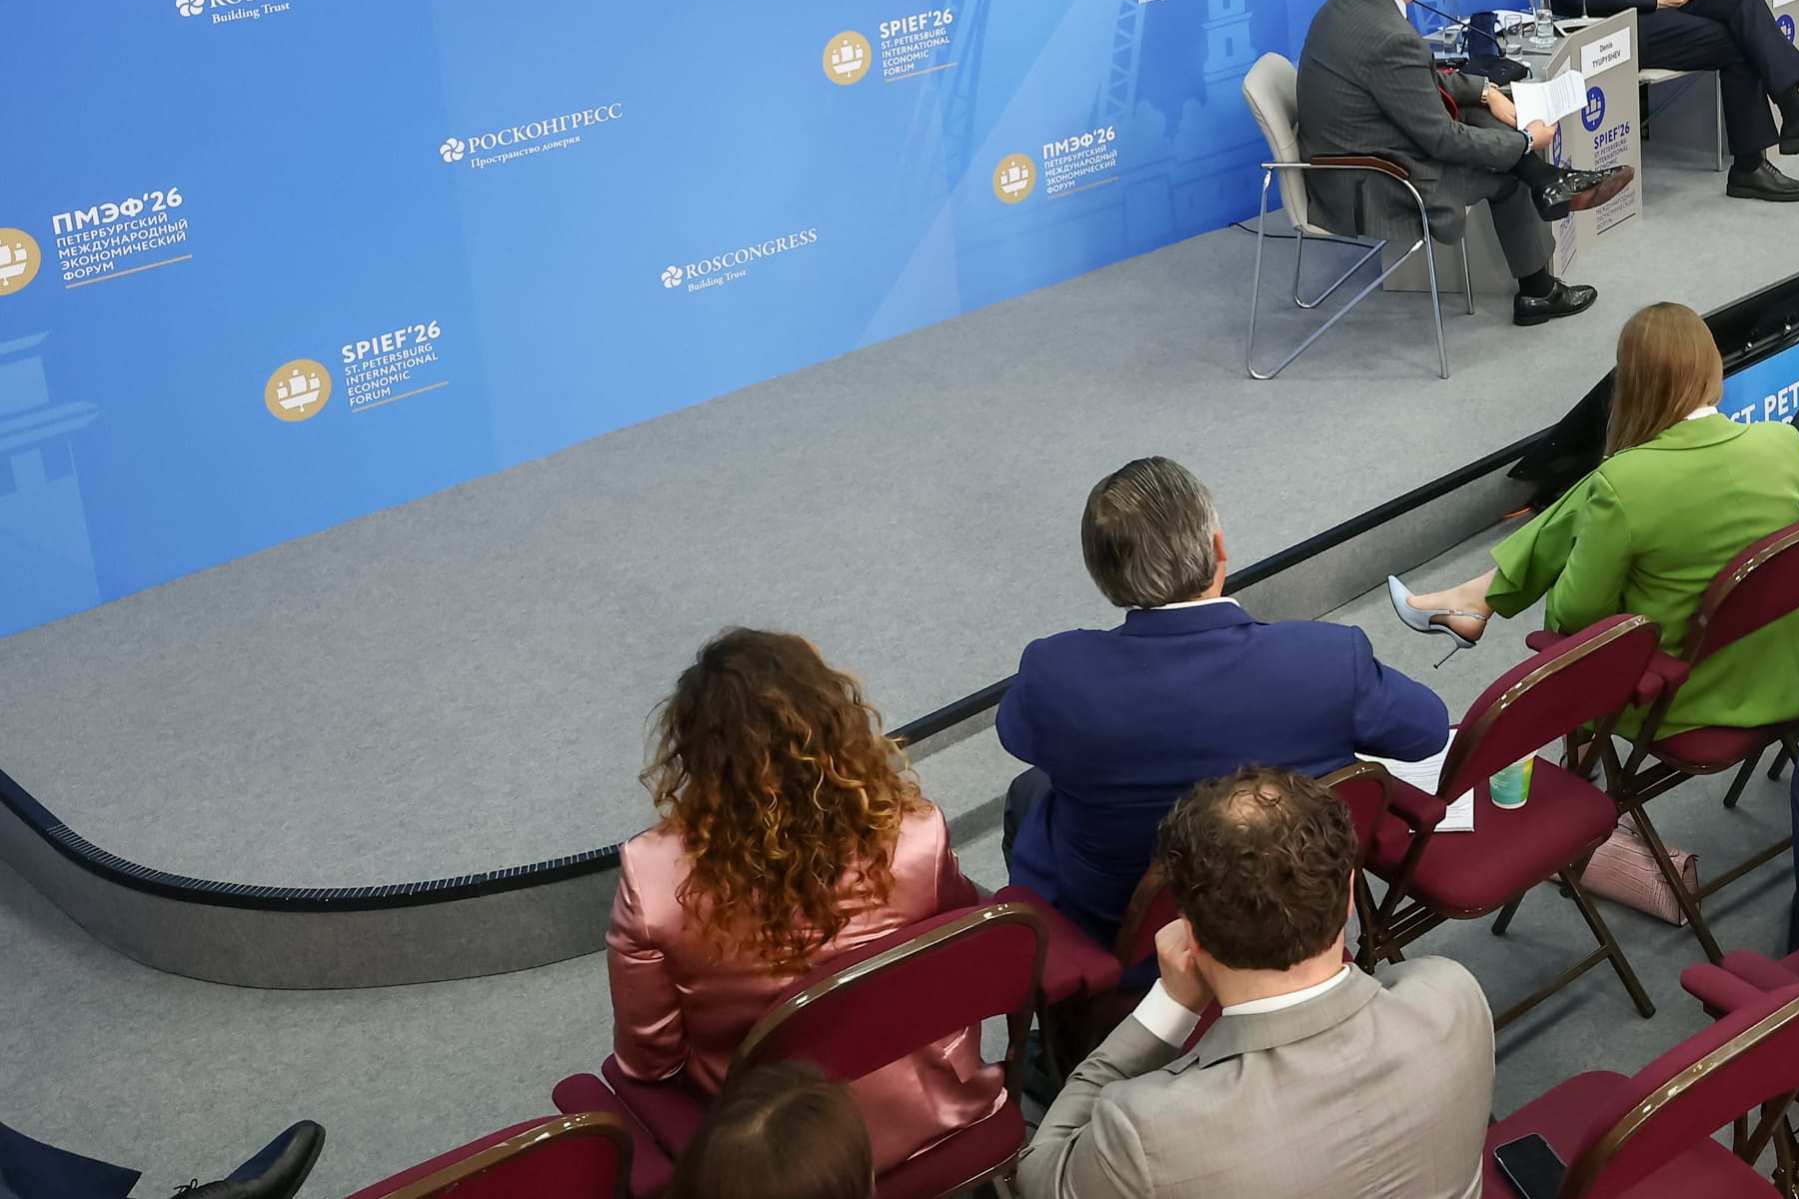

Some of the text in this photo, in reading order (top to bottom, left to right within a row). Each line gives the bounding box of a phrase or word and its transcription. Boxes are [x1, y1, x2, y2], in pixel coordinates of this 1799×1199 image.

[211, 1, 291, 24] Building Trust
[879, 8, 953, 39] SPIEF'26
[881, 37, 950, 59] INTERNATIONAL
[895, 28, 946, 46] PETERSBURG
[882, 50, 929, 68] ECONOMIC
[883, 63, 915, 77] FORUM
[468, 103, 624, 153] РОСКОНГРЕСС
[1043, 125, 1116, 159] ПМЭФ'26
[1593, 122, 1630, 149] SPIEF'26
[471, 135, 581, 168] Пространство доверия
[1045, 149, 1118, 177] МЕЖДУНАРОДНЫЙ
[1047, 159, 1116, 186] ЭКОНОМИЧЕСКИЙ
[1047, 180, 1076, 194] ФОРУМ
[52, 187, 183, 235] ПМЭФ'26
[56, 211, 168, 248] ПЕТЕРБУРГСКИЙ
[58, 218, 189, 260] МЕЖДУНАРОДНЫЙ
[61, 230, 187, 271] ЭКОНОМИЧЕСКИЙ
[686, 227, 818, 280] ROSCONGRESS
[63, 260, 115, 281] ФОРУМ
[342, 319, 441, 363] SPIEF'26
[344, 343, 433, 376] ST. PETERSBURG
[346, 352, 439, 387] INTERNATIONAL
[348, 371, 410, 397] ECONOMIC
[350, 387, 391, 407] FORUM
